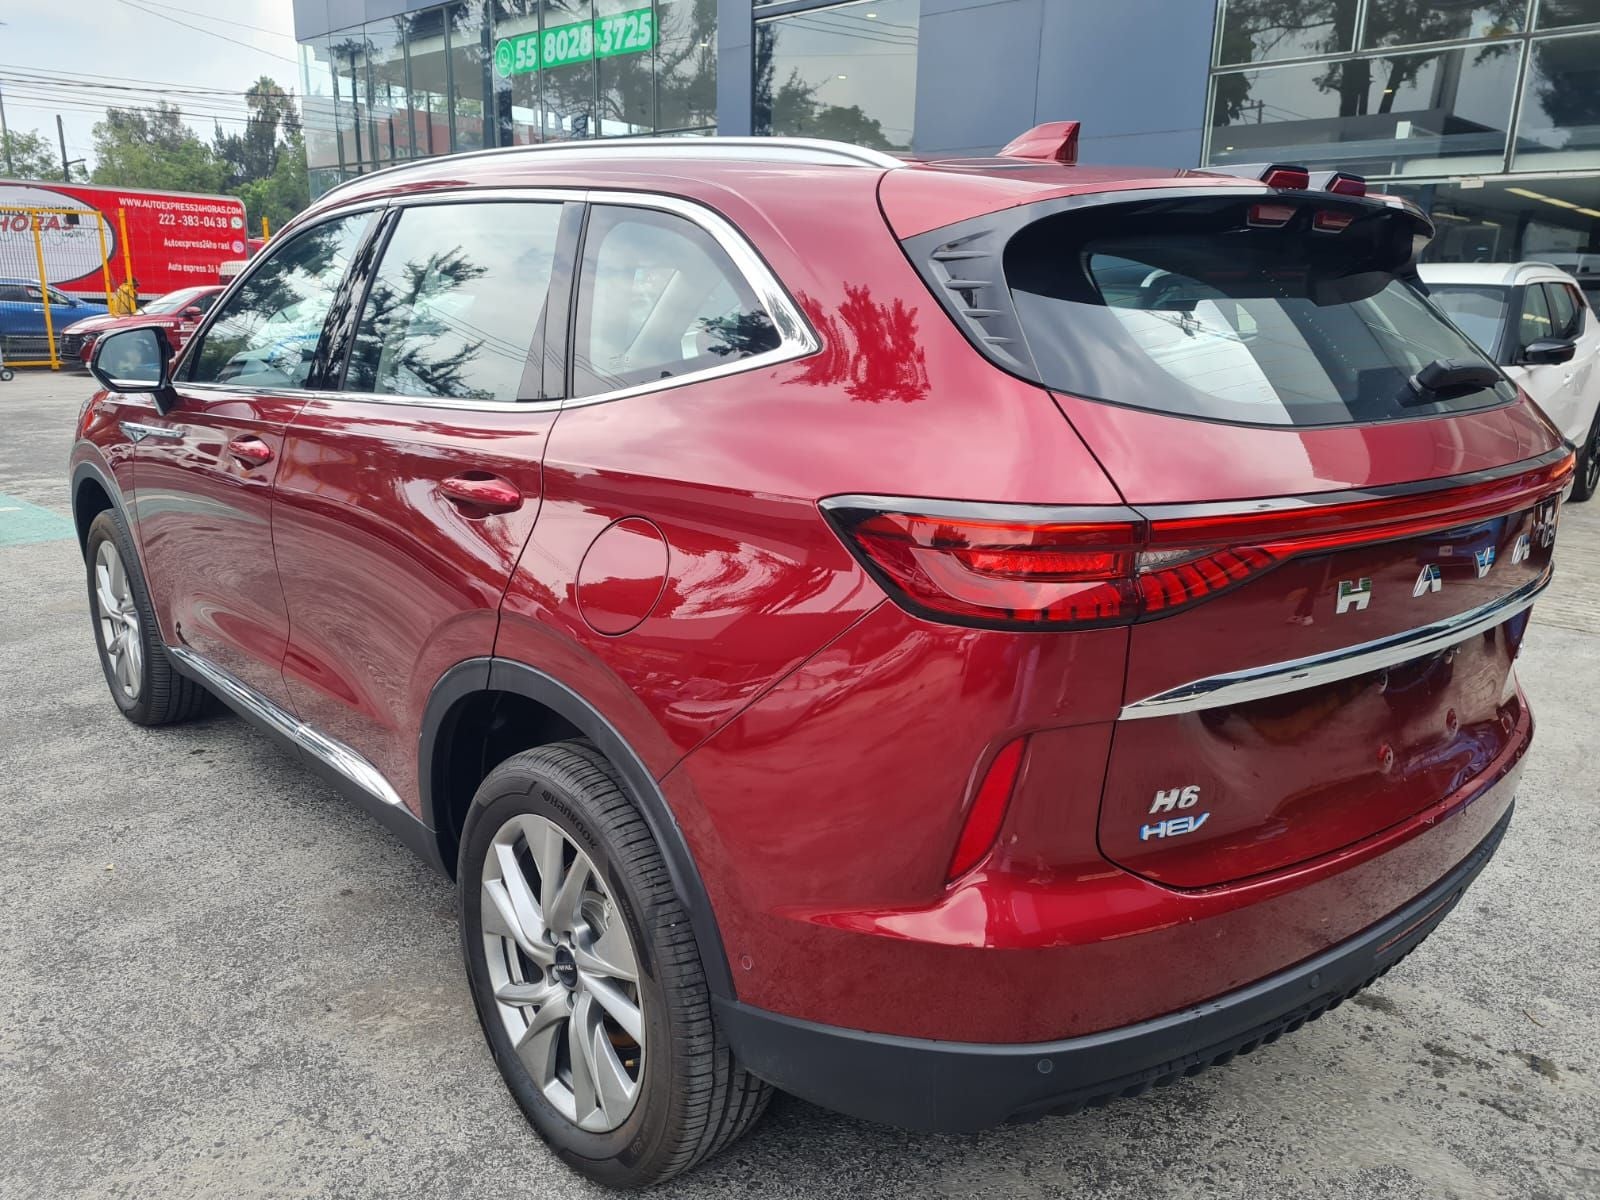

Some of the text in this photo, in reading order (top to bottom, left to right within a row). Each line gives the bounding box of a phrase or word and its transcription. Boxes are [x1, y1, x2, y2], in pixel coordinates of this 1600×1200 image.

[515, 11, 653, 70] 55 8028 3725
[1148, 784, 1201, 815] H6
[1139, 811, 1211, 841] HEV
